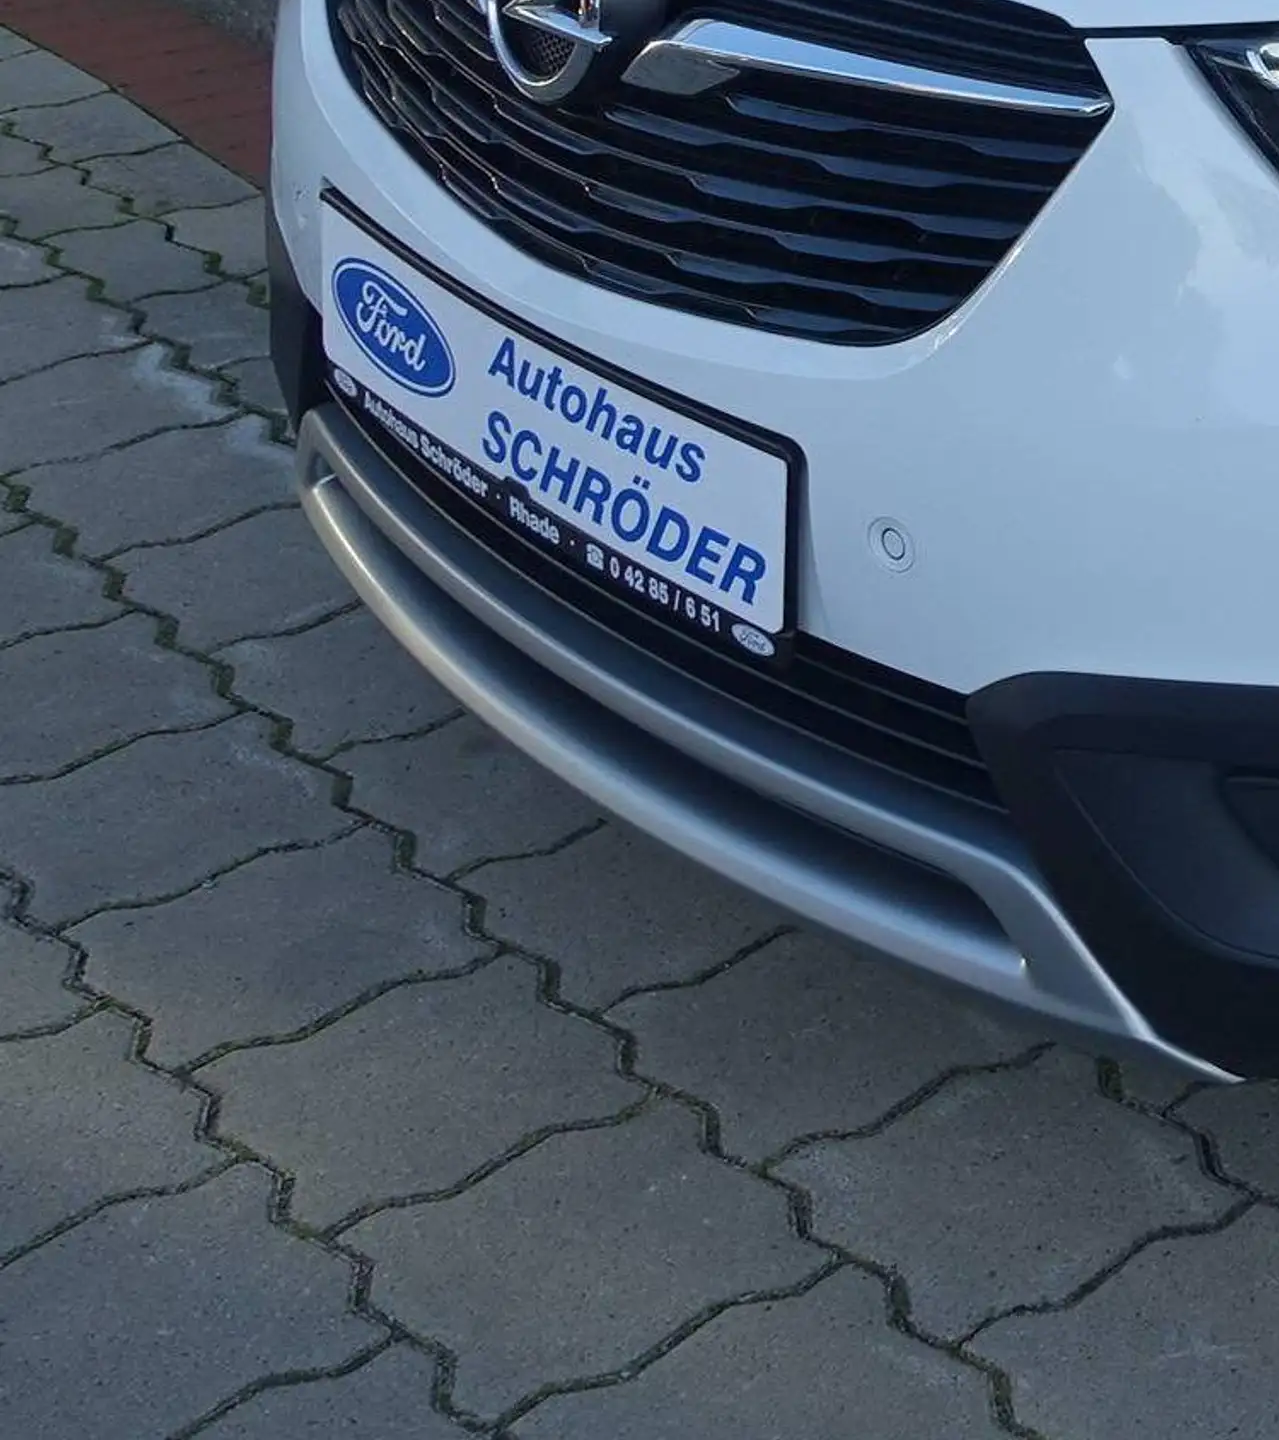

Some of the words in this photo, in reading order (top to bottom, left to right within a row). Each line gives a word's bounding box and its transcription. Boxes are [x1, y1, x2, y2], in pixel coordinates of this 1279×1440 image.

[356, 280, 427, 372] Ford
[488, 336, 706, 483] Autohaus
[363, 392, 419, 449] Autohaus
[419, 433, 490, 498] Schröder
[509, 496, 561, 546] Rhade
[609, 557, 620, 580] 0
[624, 565, 646, 594] 42
[648, 577, 670, 606] 85
[685, 596, 697, 621] 6
[701, 606, 720, 633] 51
[482, 410, 766, 606] SCHRÖDER
